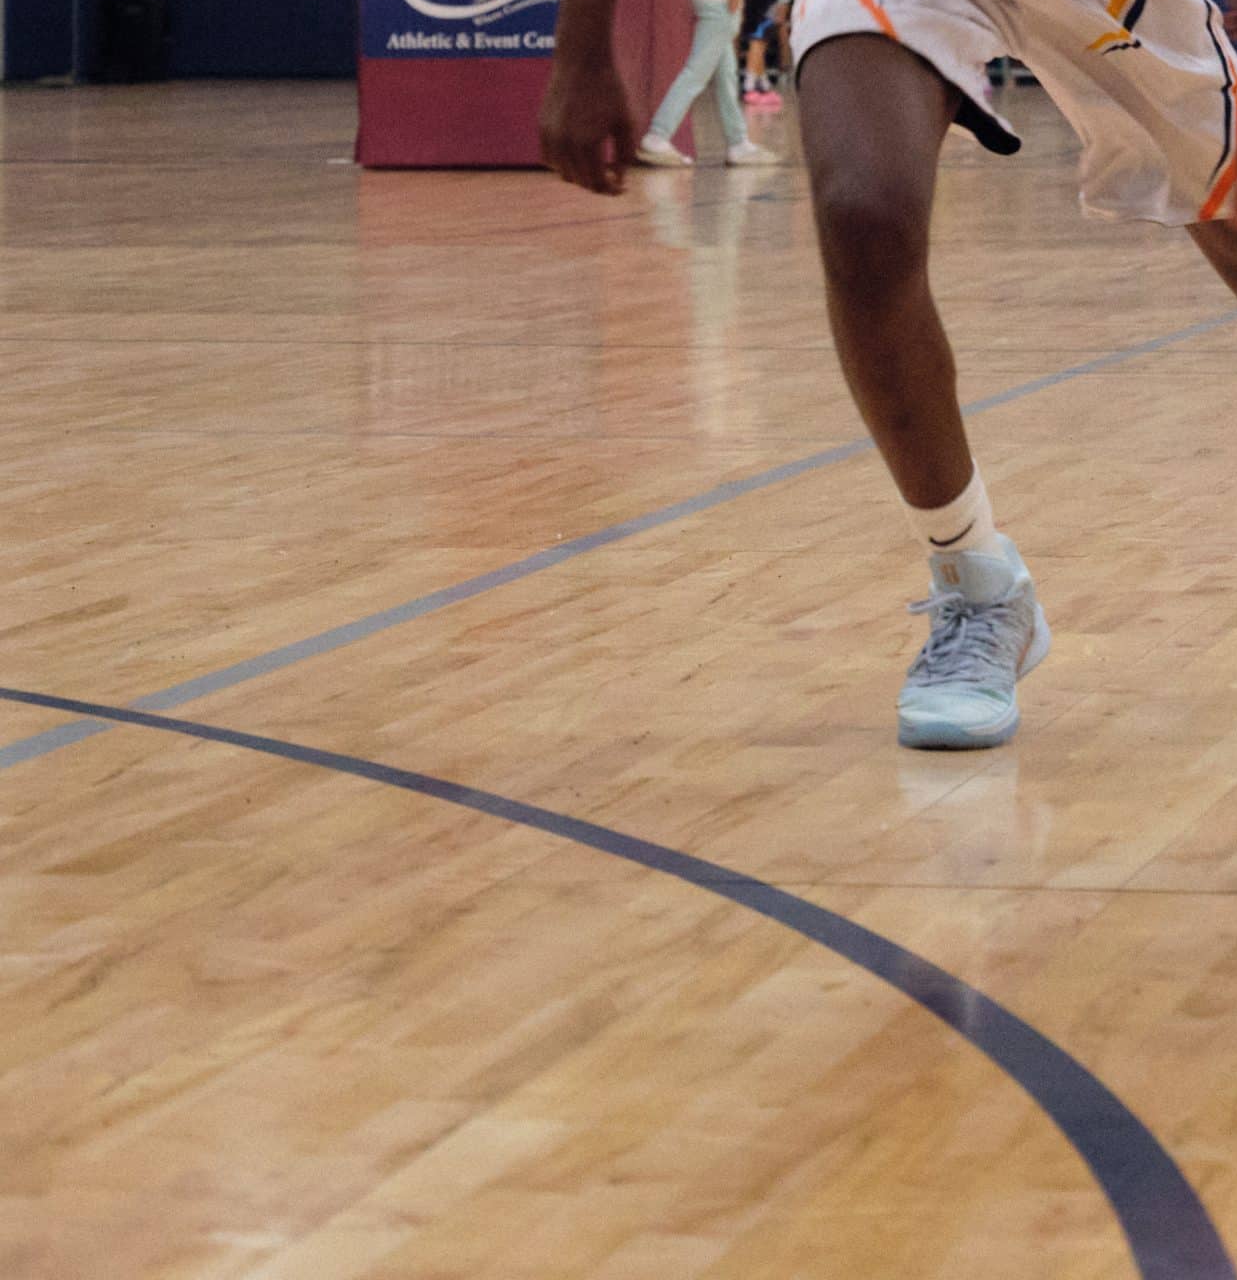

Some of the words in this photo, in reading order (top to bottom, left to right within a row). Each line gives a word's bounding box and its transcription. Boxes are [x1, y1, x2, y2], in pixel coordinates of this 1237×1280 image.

[386, 31, 452, 50] Athletic
[455, 32, 471, 49] &
[474, 32, 520, 49] Event
